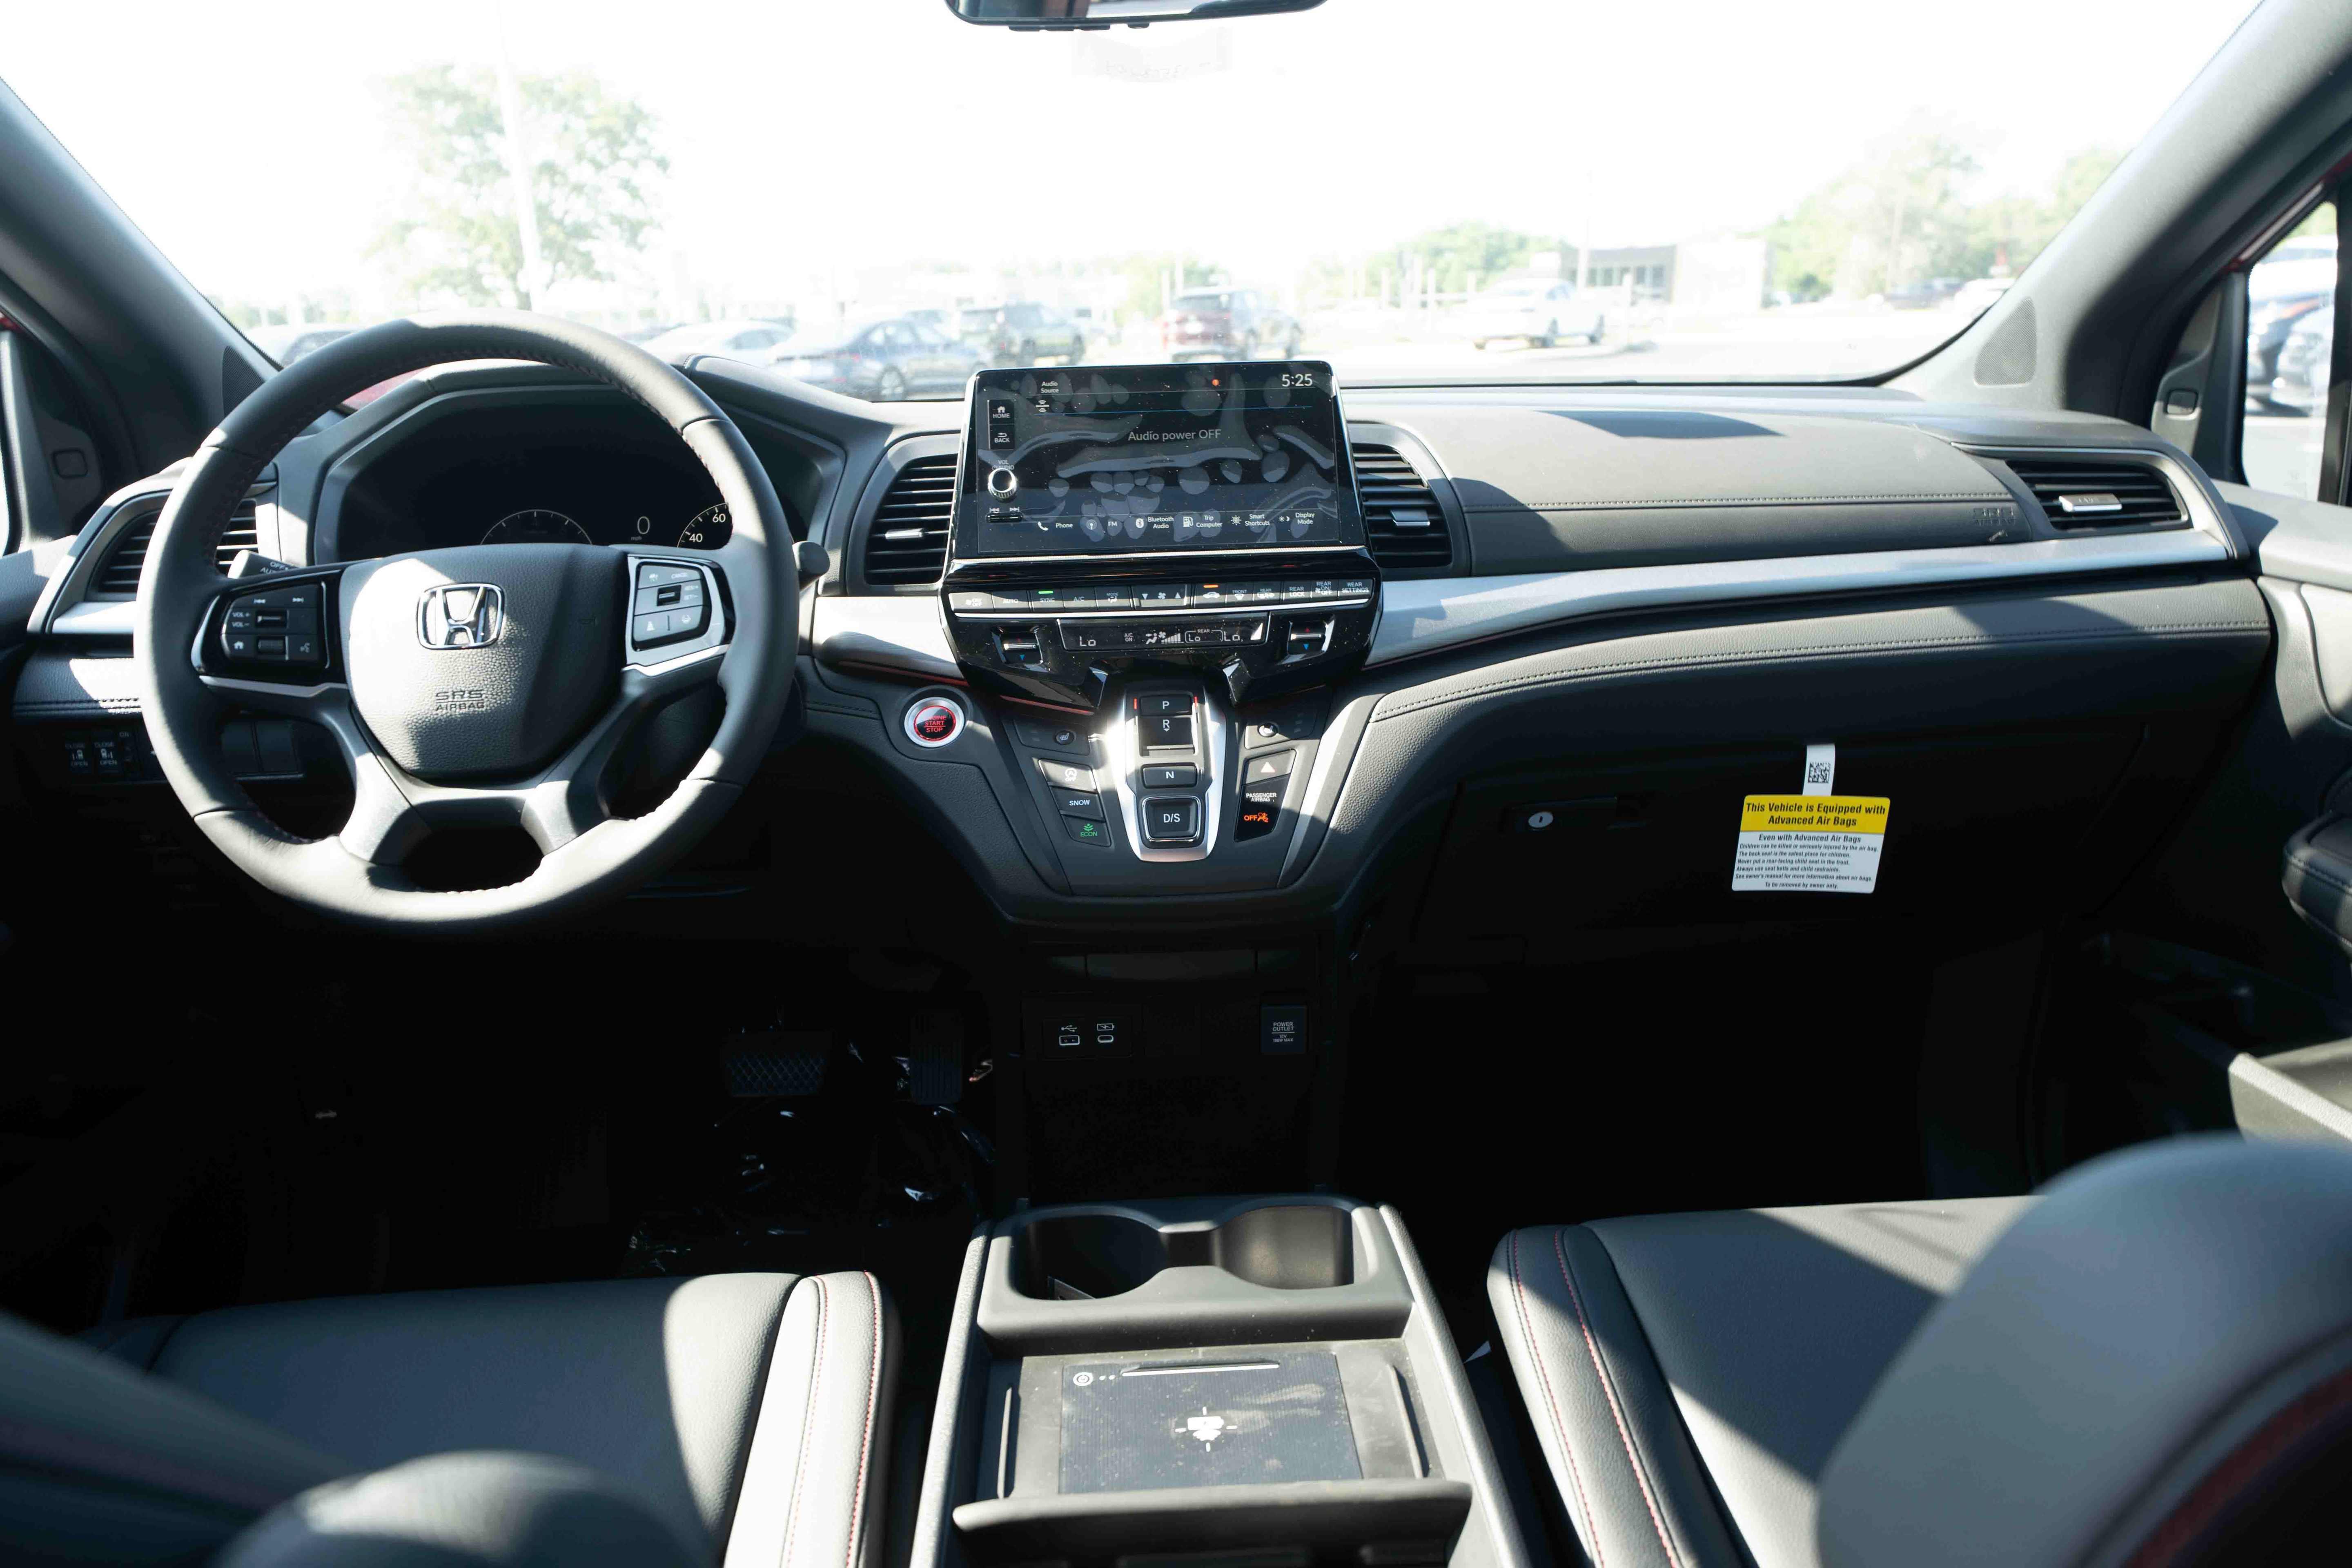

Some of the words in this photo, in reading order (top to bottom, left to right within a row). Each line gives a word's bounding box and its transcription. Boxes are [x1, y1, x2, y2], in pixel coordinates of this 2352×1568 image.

[1282, 374, 1313, 387] 5:25
[1128, 431, 1159, 441] Audio
[1162, 431, 1196, 441] power
[1199, 429, 1222, 439] OFF
[712, 514, 726, 523] 60
[637, 516, 650, 534] 0
[689, 533, 703, 542] 40
[436, 689, 484, 701] SRS
[435, 702, 485, 711] AIRBAG
[1163, 701, 1169, 709] P
[1163, 719, 1170, 728] R
[1747, 803, 1765, 812] This
[1768, 803, 1802, 813] Vehicle
[1806, 804, 1813, 813] is
[1817, 803, 1861, 815] Equipped
[1864, 805, 1885, 815] with
[1163, 813, 1180, 823] D/S
[1768, 815, 1814, 825] Advanced
[1816, 815, 1831, 825] Air
[1833, 816, 1857, 828] Bags
[1843, 835, 1861, 843] Bags
